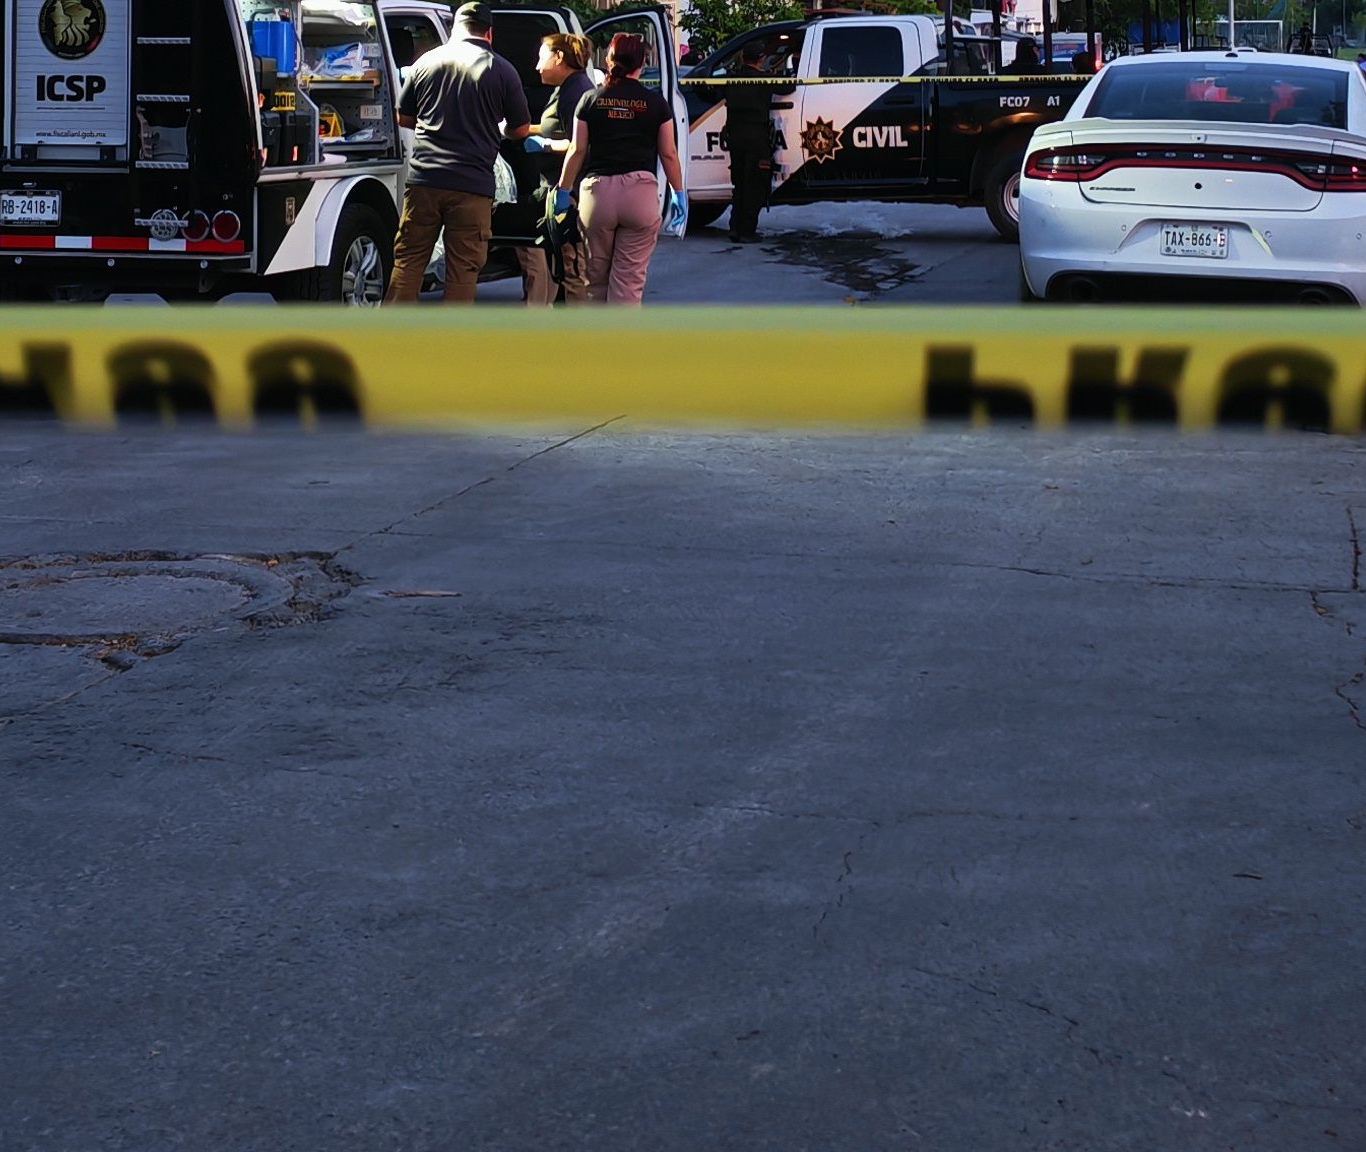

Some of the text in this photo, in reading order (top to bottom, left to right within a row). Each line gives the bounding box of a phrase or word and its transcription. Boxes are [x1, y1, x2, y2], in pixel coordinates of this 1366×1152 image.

[36, 74, 107, 102] ICSP
[999, 95, 1060, 108] FC07 A1
[852, 125, 909, 149] CIVIL
[1, 199, 58, 215] RB-2418-A
